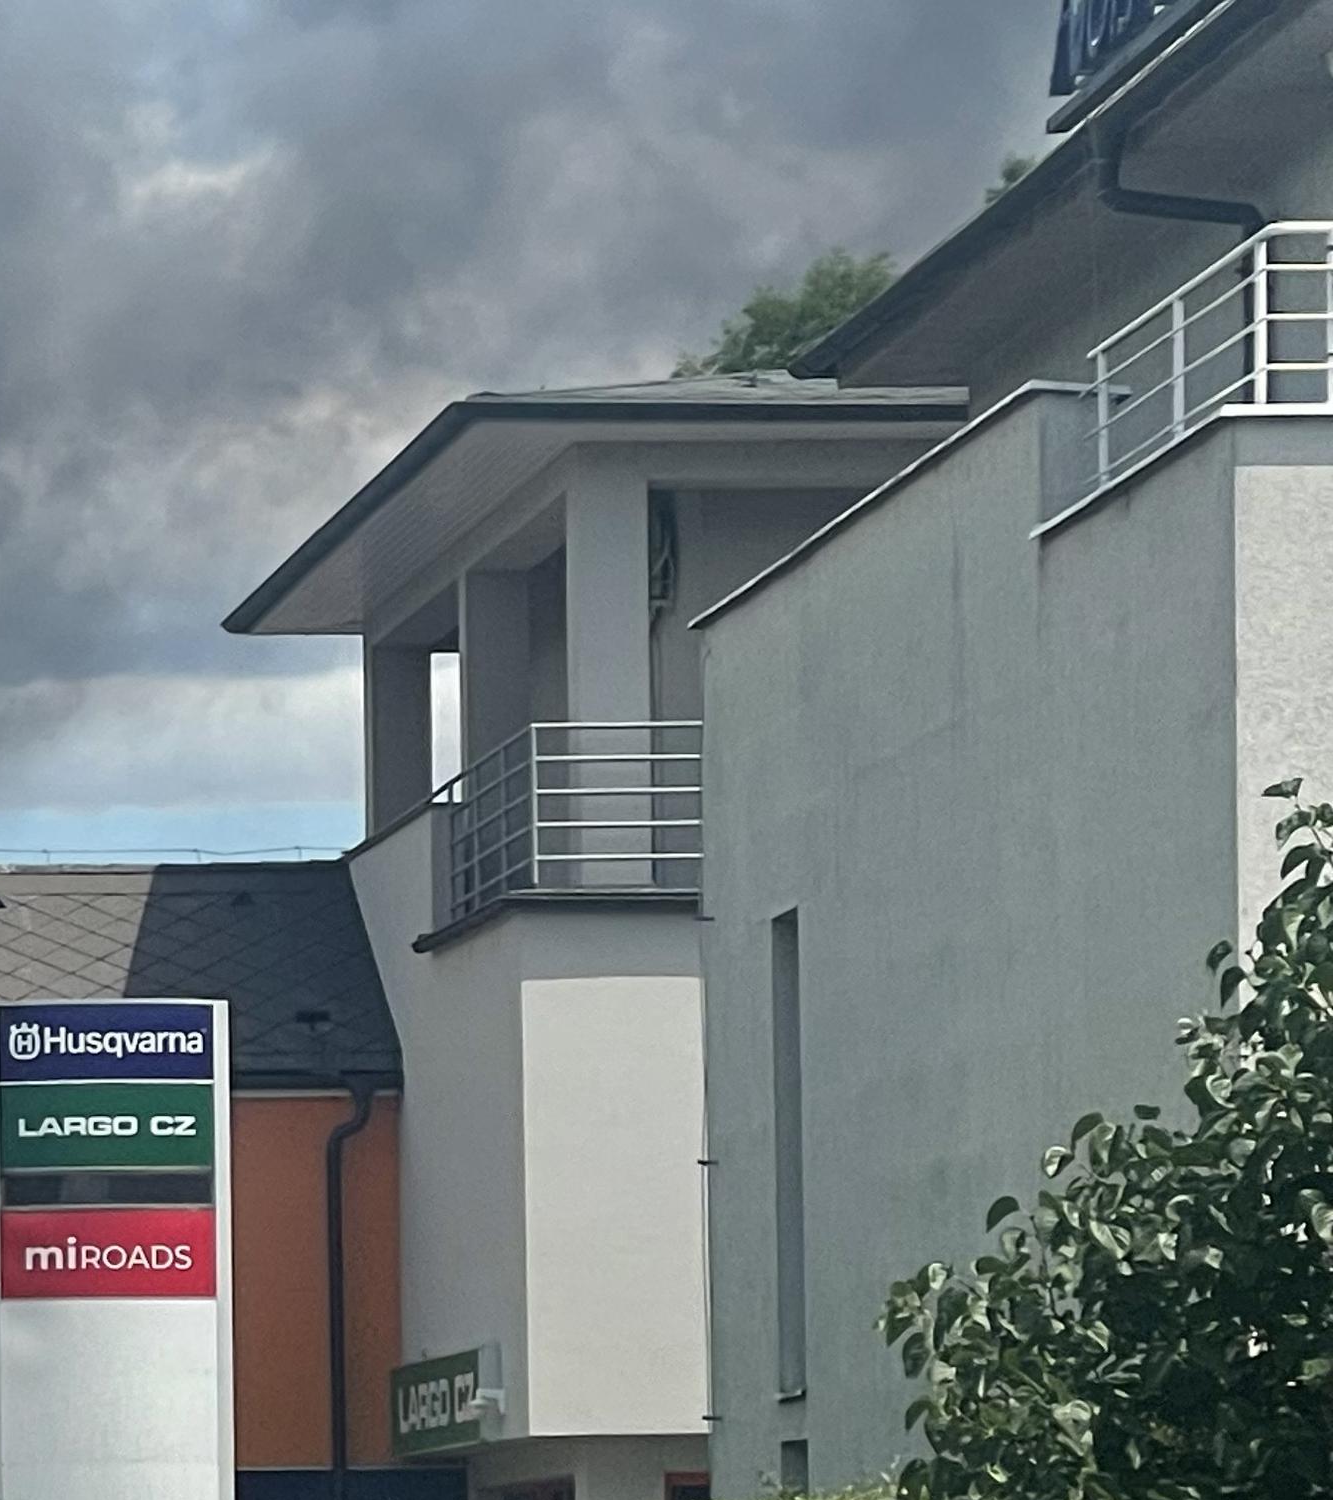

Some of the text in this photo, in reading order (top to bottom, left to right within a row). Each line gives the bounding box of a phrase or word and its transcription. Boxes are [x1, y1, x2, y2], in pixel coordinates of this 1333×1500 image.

[43, 1027, 204, 1058] Husqvarna
[18, 1116, 197, 1137] LARGO CZ
[25, 1236, 193, 1270] miROADS
[397, 1371, 479, 1434] LARGO CZ
